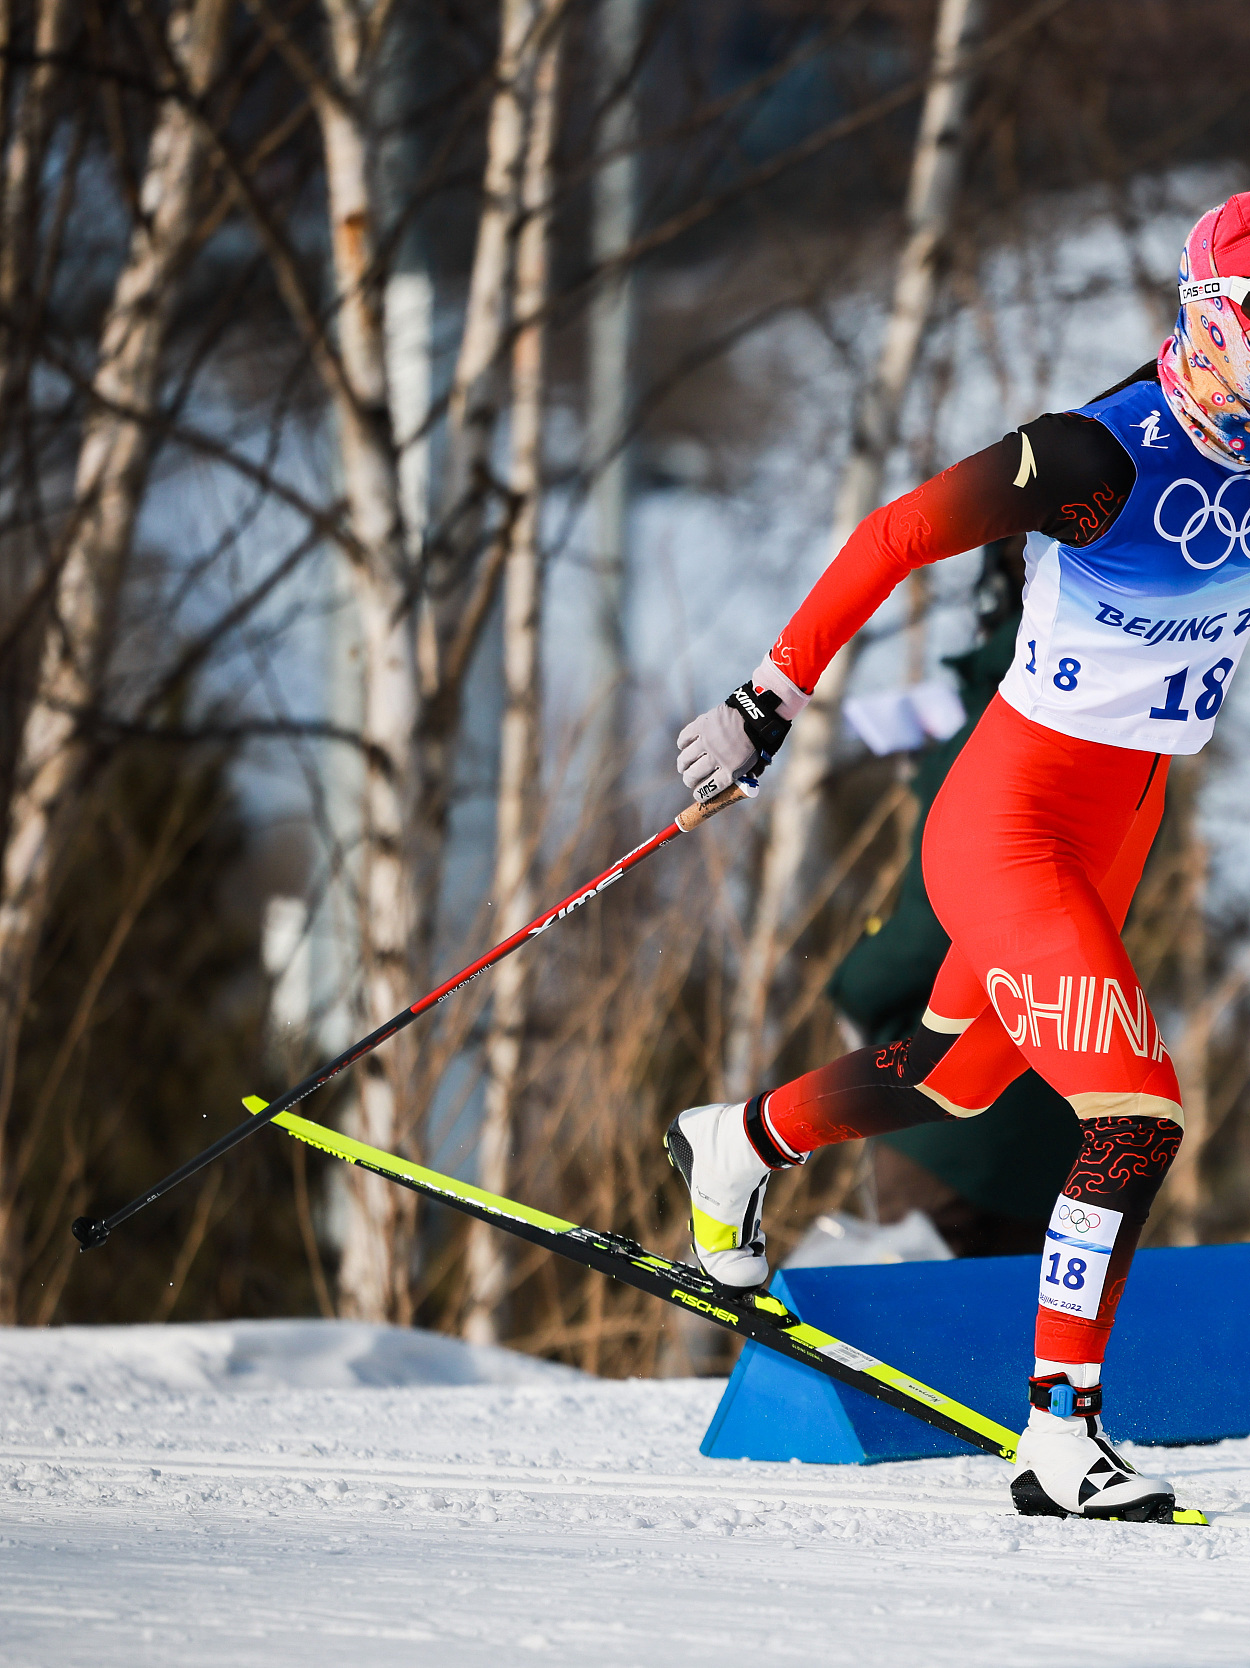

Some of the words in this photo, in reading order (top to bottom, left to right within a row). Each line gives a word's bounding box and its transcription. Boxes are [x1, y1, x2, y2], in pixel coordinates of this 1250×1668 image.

[1095, 600, 1228, 647] BEIJING
[1149, 656, 1234, 722] 18
[1045, 1252, 1087, 1290] 18
[671, 1288, 739, 1326] FISCHER
[1060, 1300, 1083, 1312] 2022
